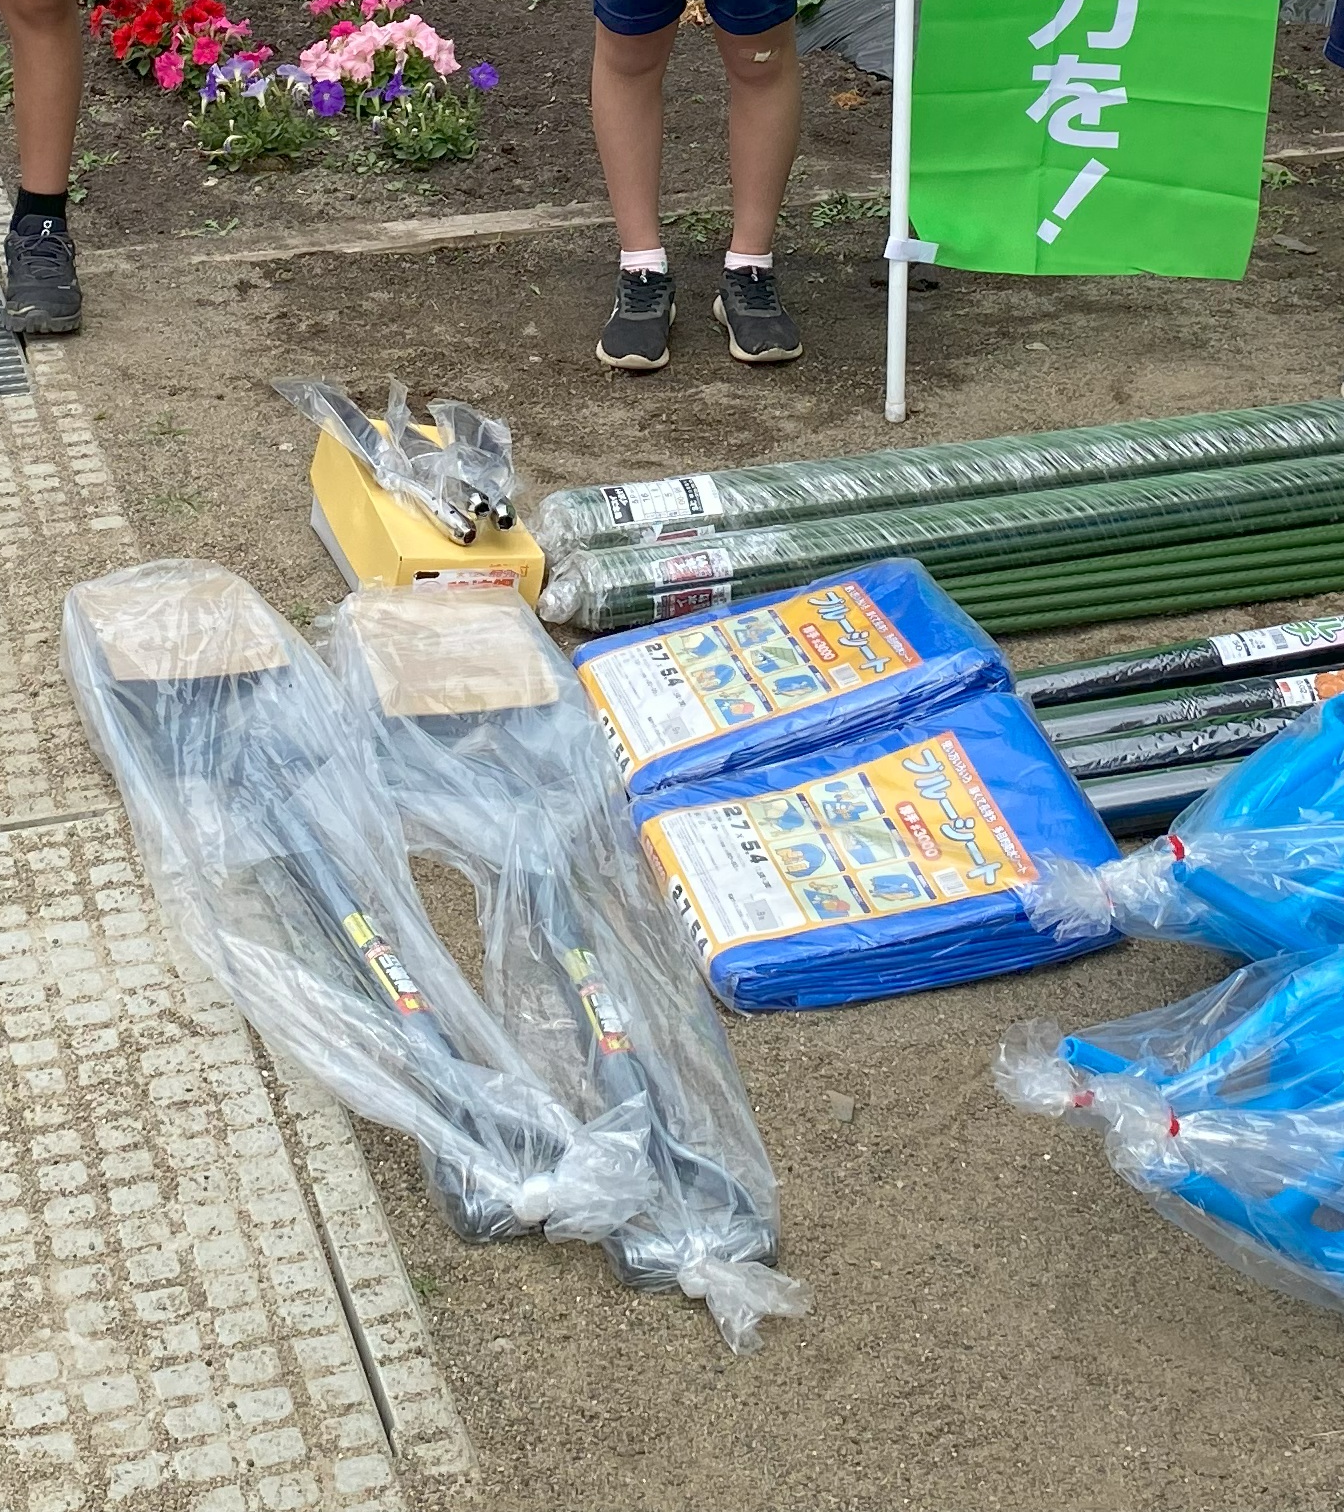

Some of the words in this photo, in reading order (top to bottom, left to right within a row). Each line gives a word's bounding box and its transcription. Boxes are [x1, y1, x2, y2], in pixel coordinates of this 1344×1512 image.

[807, 591, 892, 673] ブルーシート
[902, 748, 1003, 885] ブルーシート
